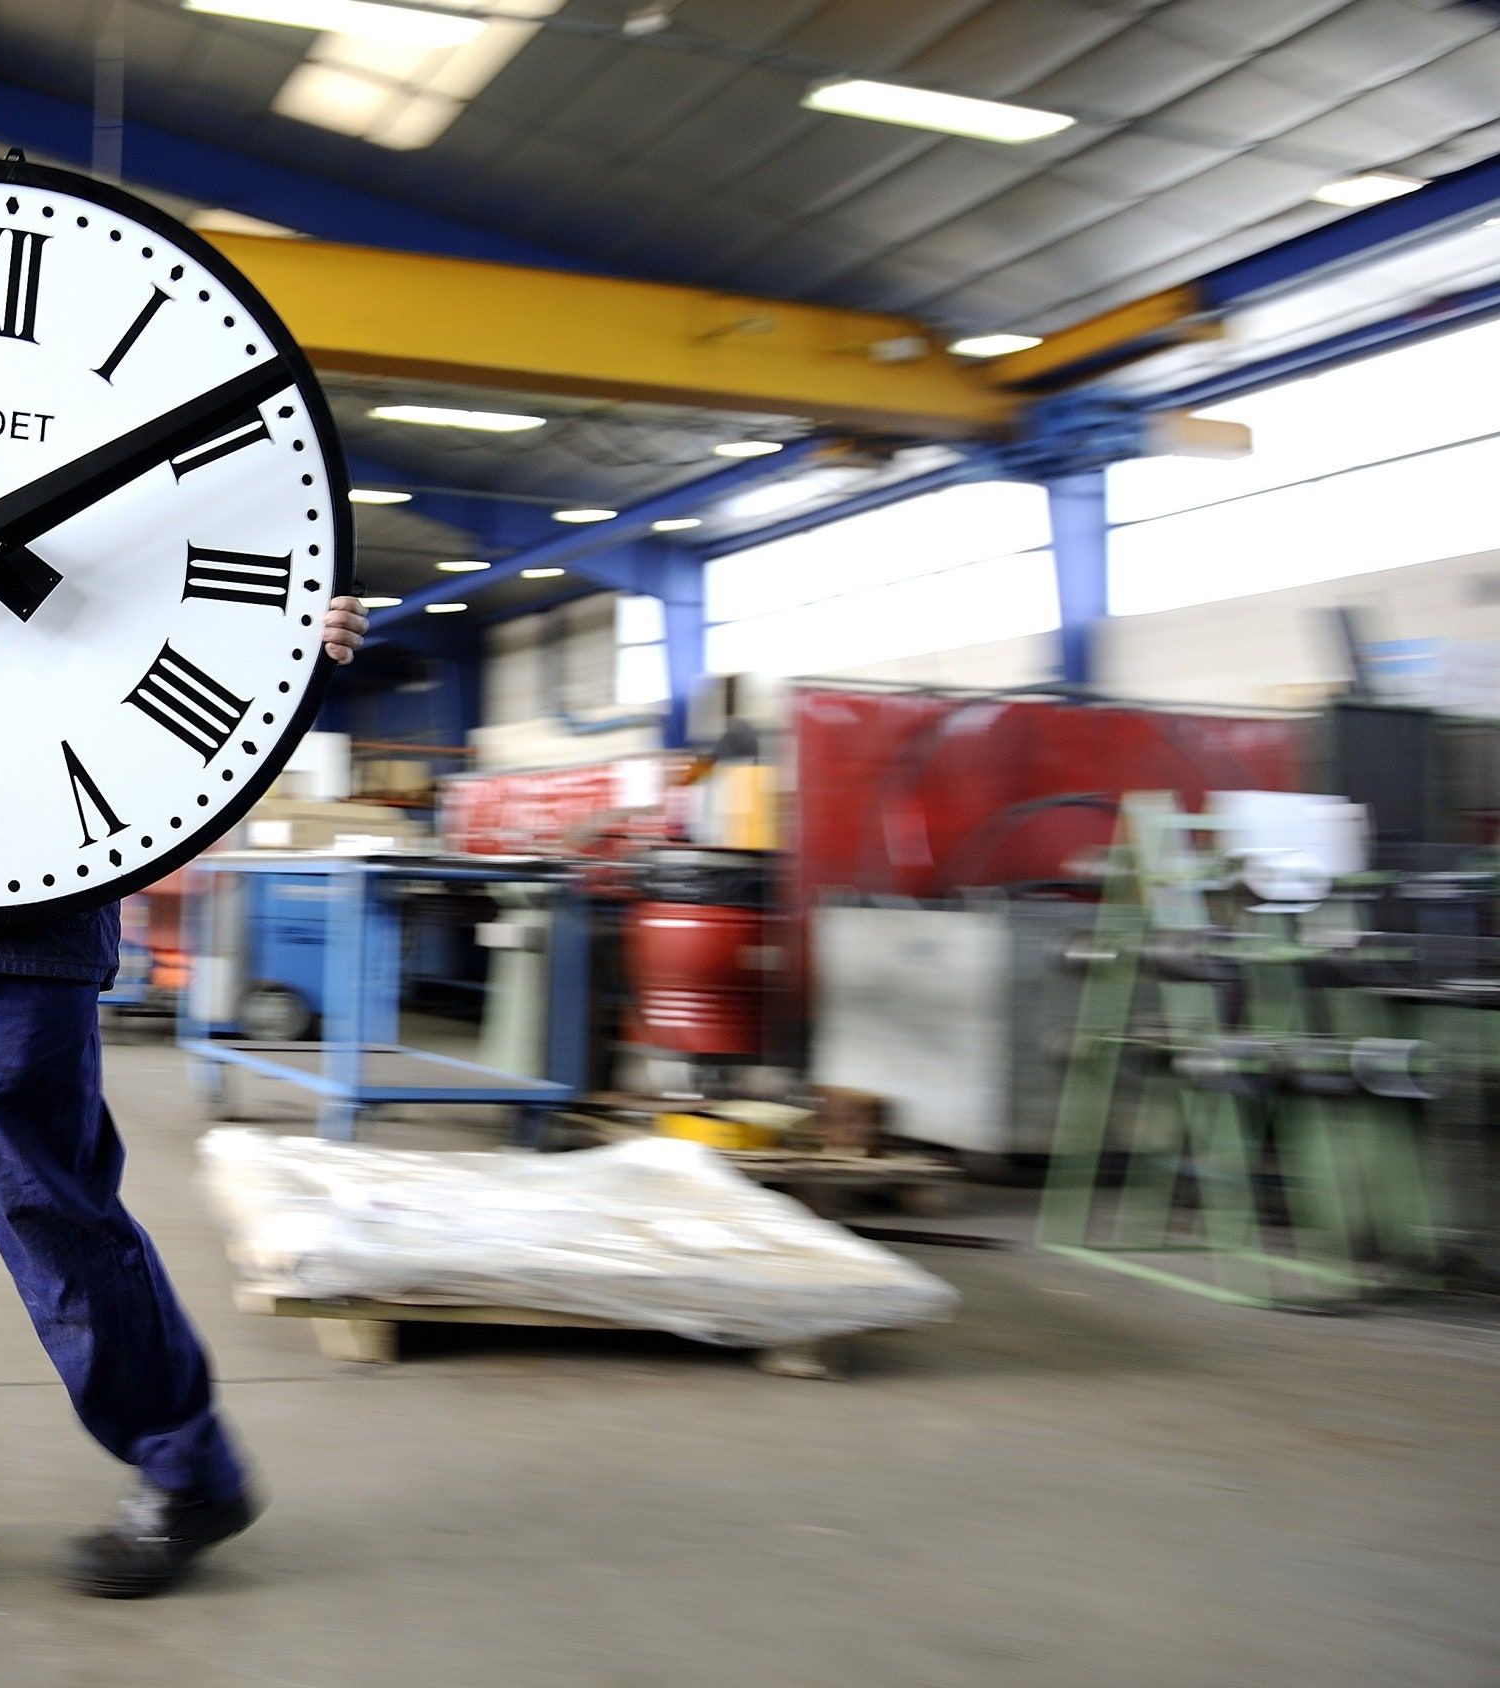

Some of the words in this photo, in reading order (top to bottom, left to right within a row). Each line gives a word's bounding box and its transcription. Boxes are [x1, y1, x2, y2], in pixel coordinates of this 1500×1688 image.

[90, 282, 175, 386] I
[180, 540, 294, 615] III
[120, 637, 256, 769] IIII
[60, 739, 131, 850] V
